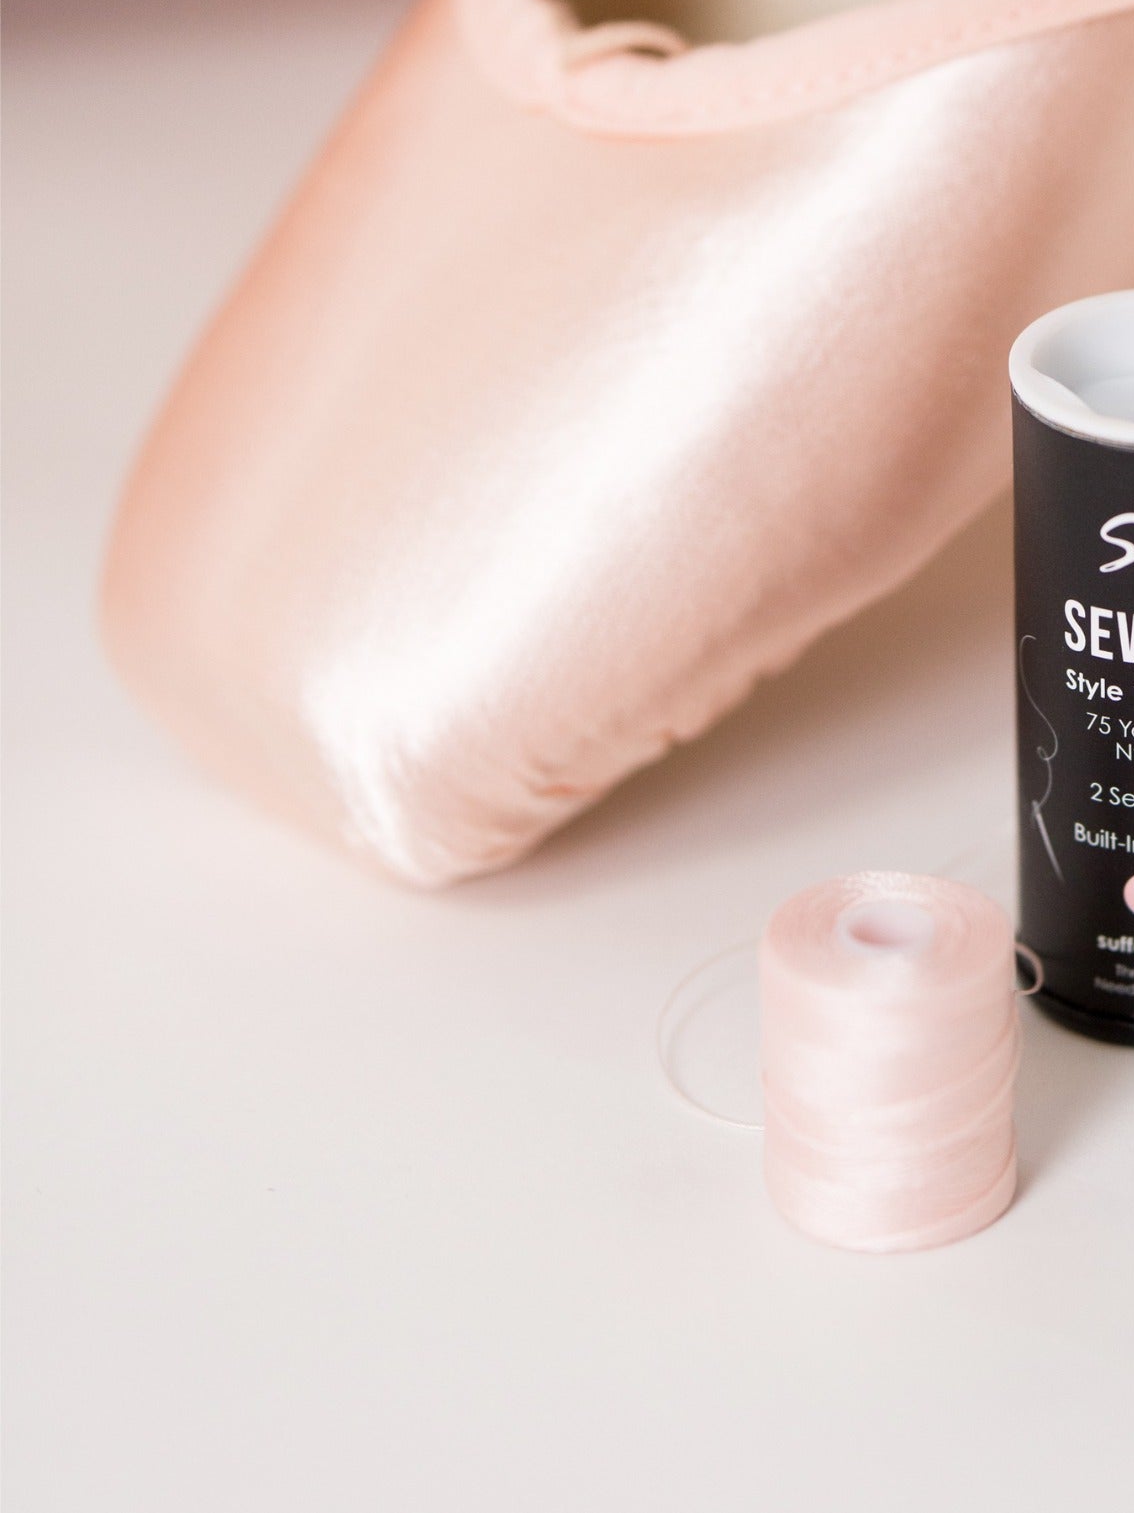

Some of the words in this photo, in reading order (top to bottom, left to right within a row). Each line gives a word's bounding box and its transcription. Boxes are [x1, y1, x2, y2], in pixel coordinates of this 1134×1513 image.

[1066, 668, 1123, 701] Style
[1086, 712, 1111, 735] 75
[1090, 783, 1103, 802] 2
